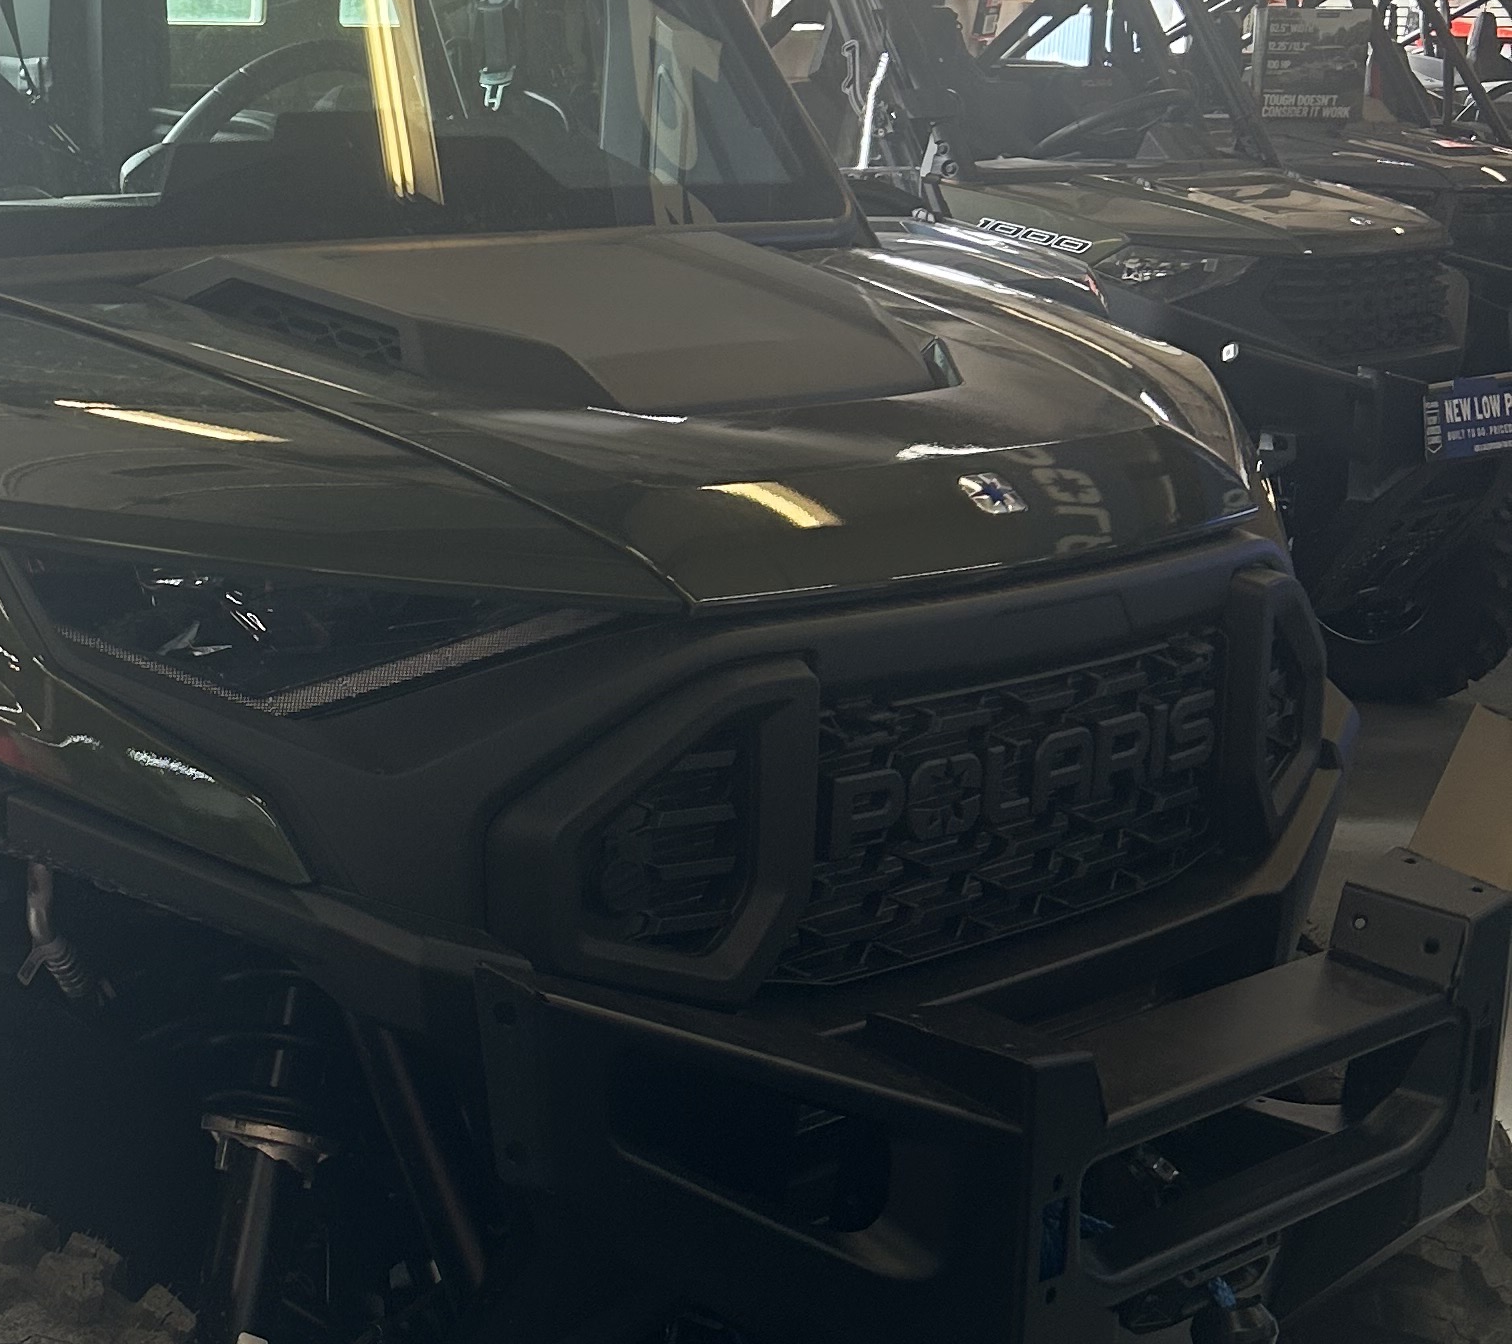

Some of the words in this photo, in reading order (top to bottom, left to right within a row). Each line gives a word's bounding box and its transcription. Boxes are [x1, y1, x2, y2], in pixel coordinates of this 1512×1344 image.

[1262, 106, 1308, 118] CONSIDER
[1308, 106, 1320, 118] IT
[1322, 106, 1350, 118] WORK
[1263, 94, 1296, 106] TOUGH
[1297, 94, 1338, 106] DOESN'T
[976, 217, 1092, 254] 1000
[1444, 397, 1471, 424] NEW
[1474, 393, 1501, 420] LOW
[831, 688, 1216, 860] POLARIS
